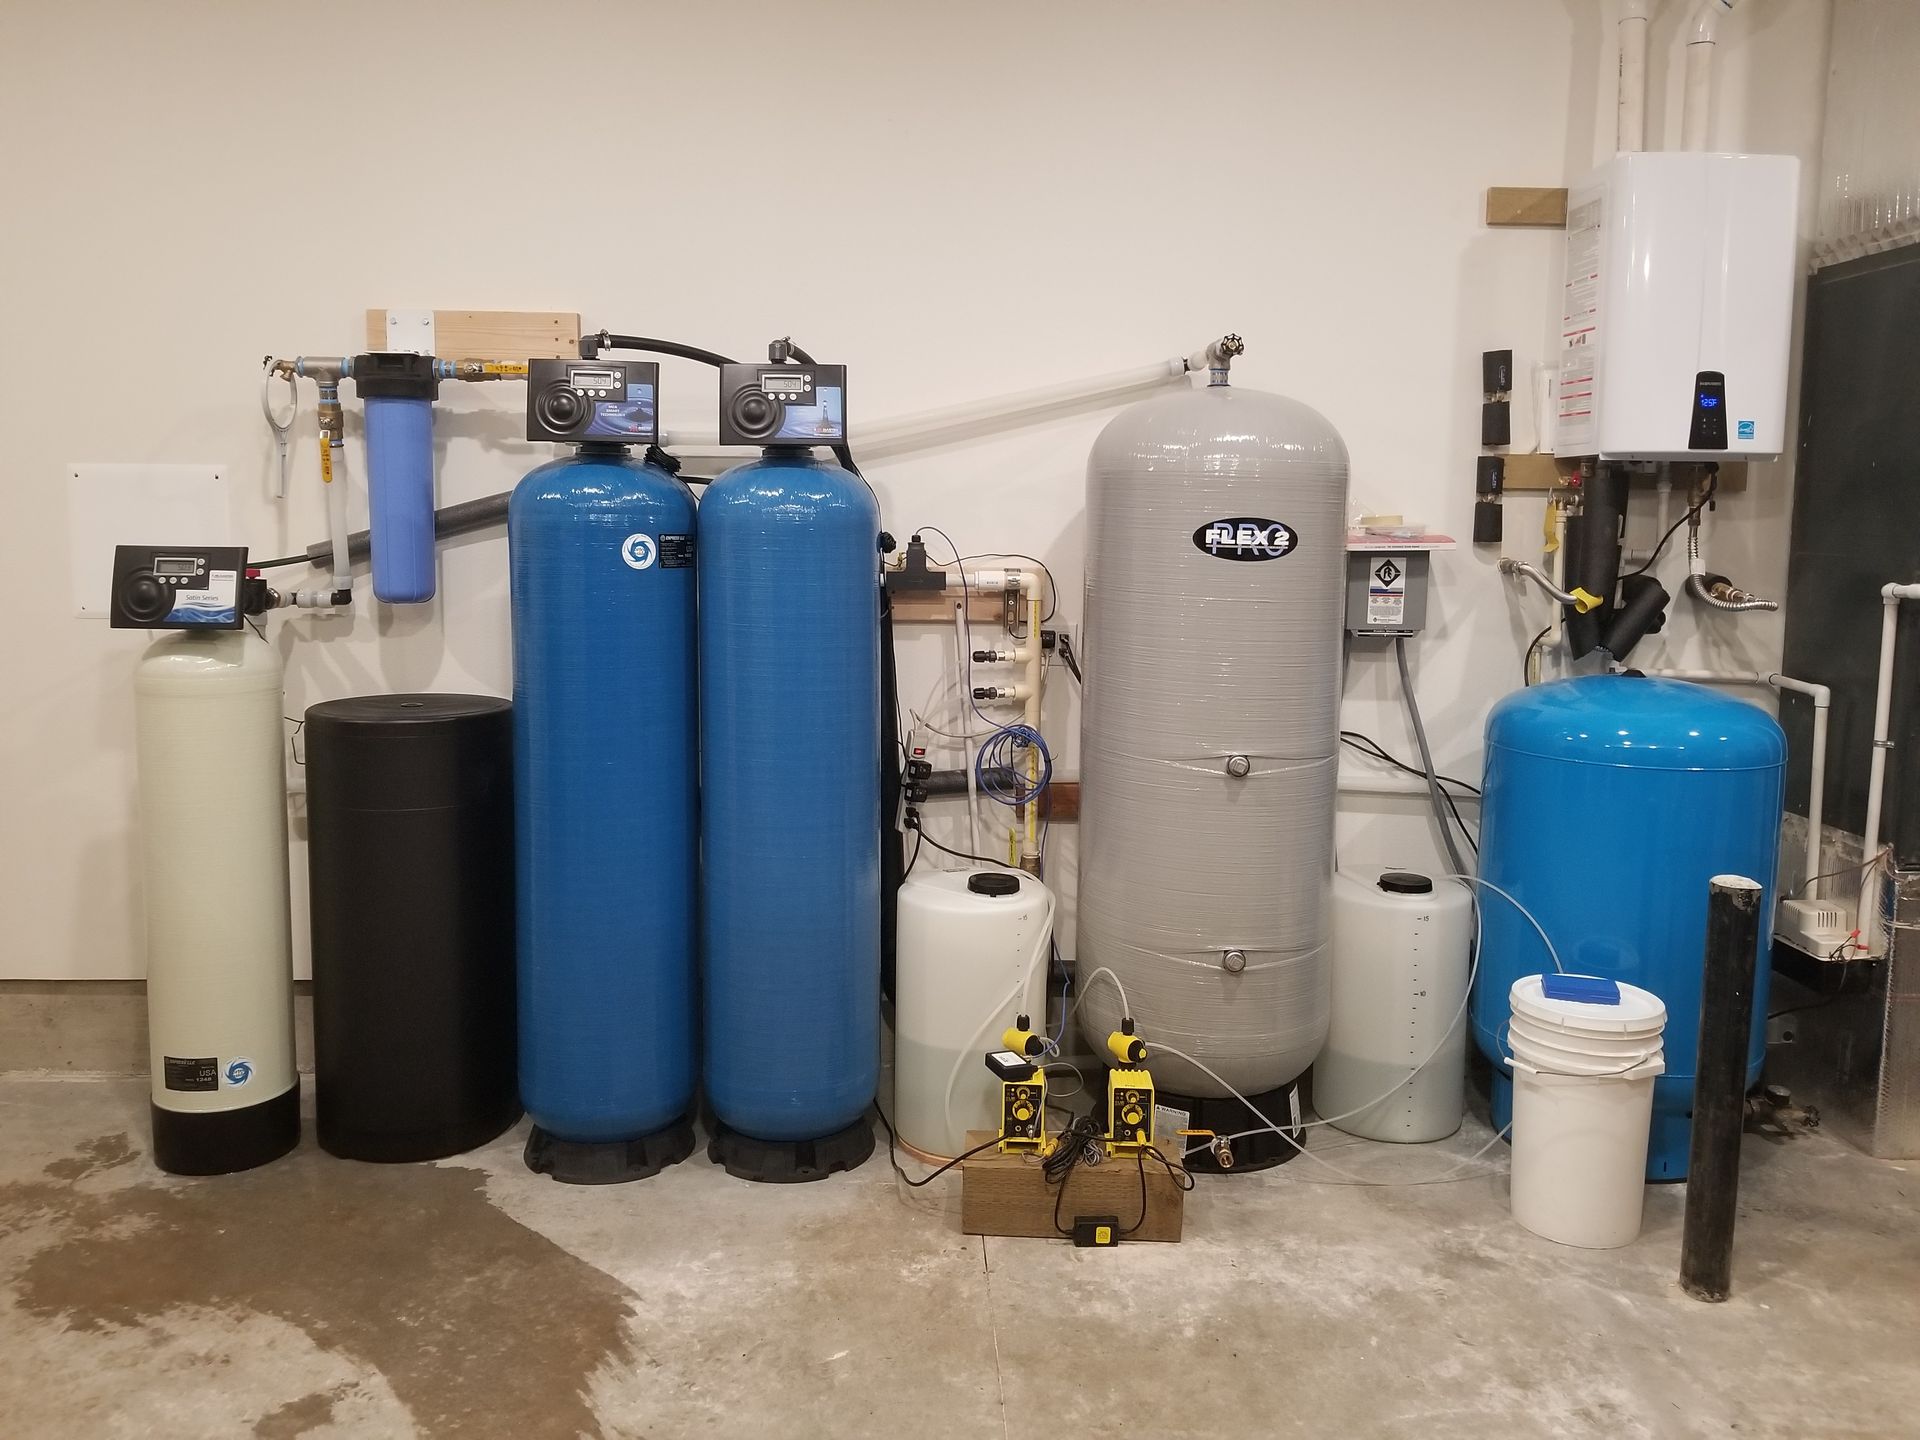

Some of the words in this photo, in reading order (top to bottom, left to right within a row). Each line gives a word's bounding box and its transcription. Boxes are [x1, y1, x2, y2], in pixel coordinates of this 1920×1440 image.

[1205, 529, 1268, 545] FLEX
[1274, 531, 1290, 546] 2
[199, 1069, 217, 1077] USA
[1161, 1106, 1187, 1117] WARNING
